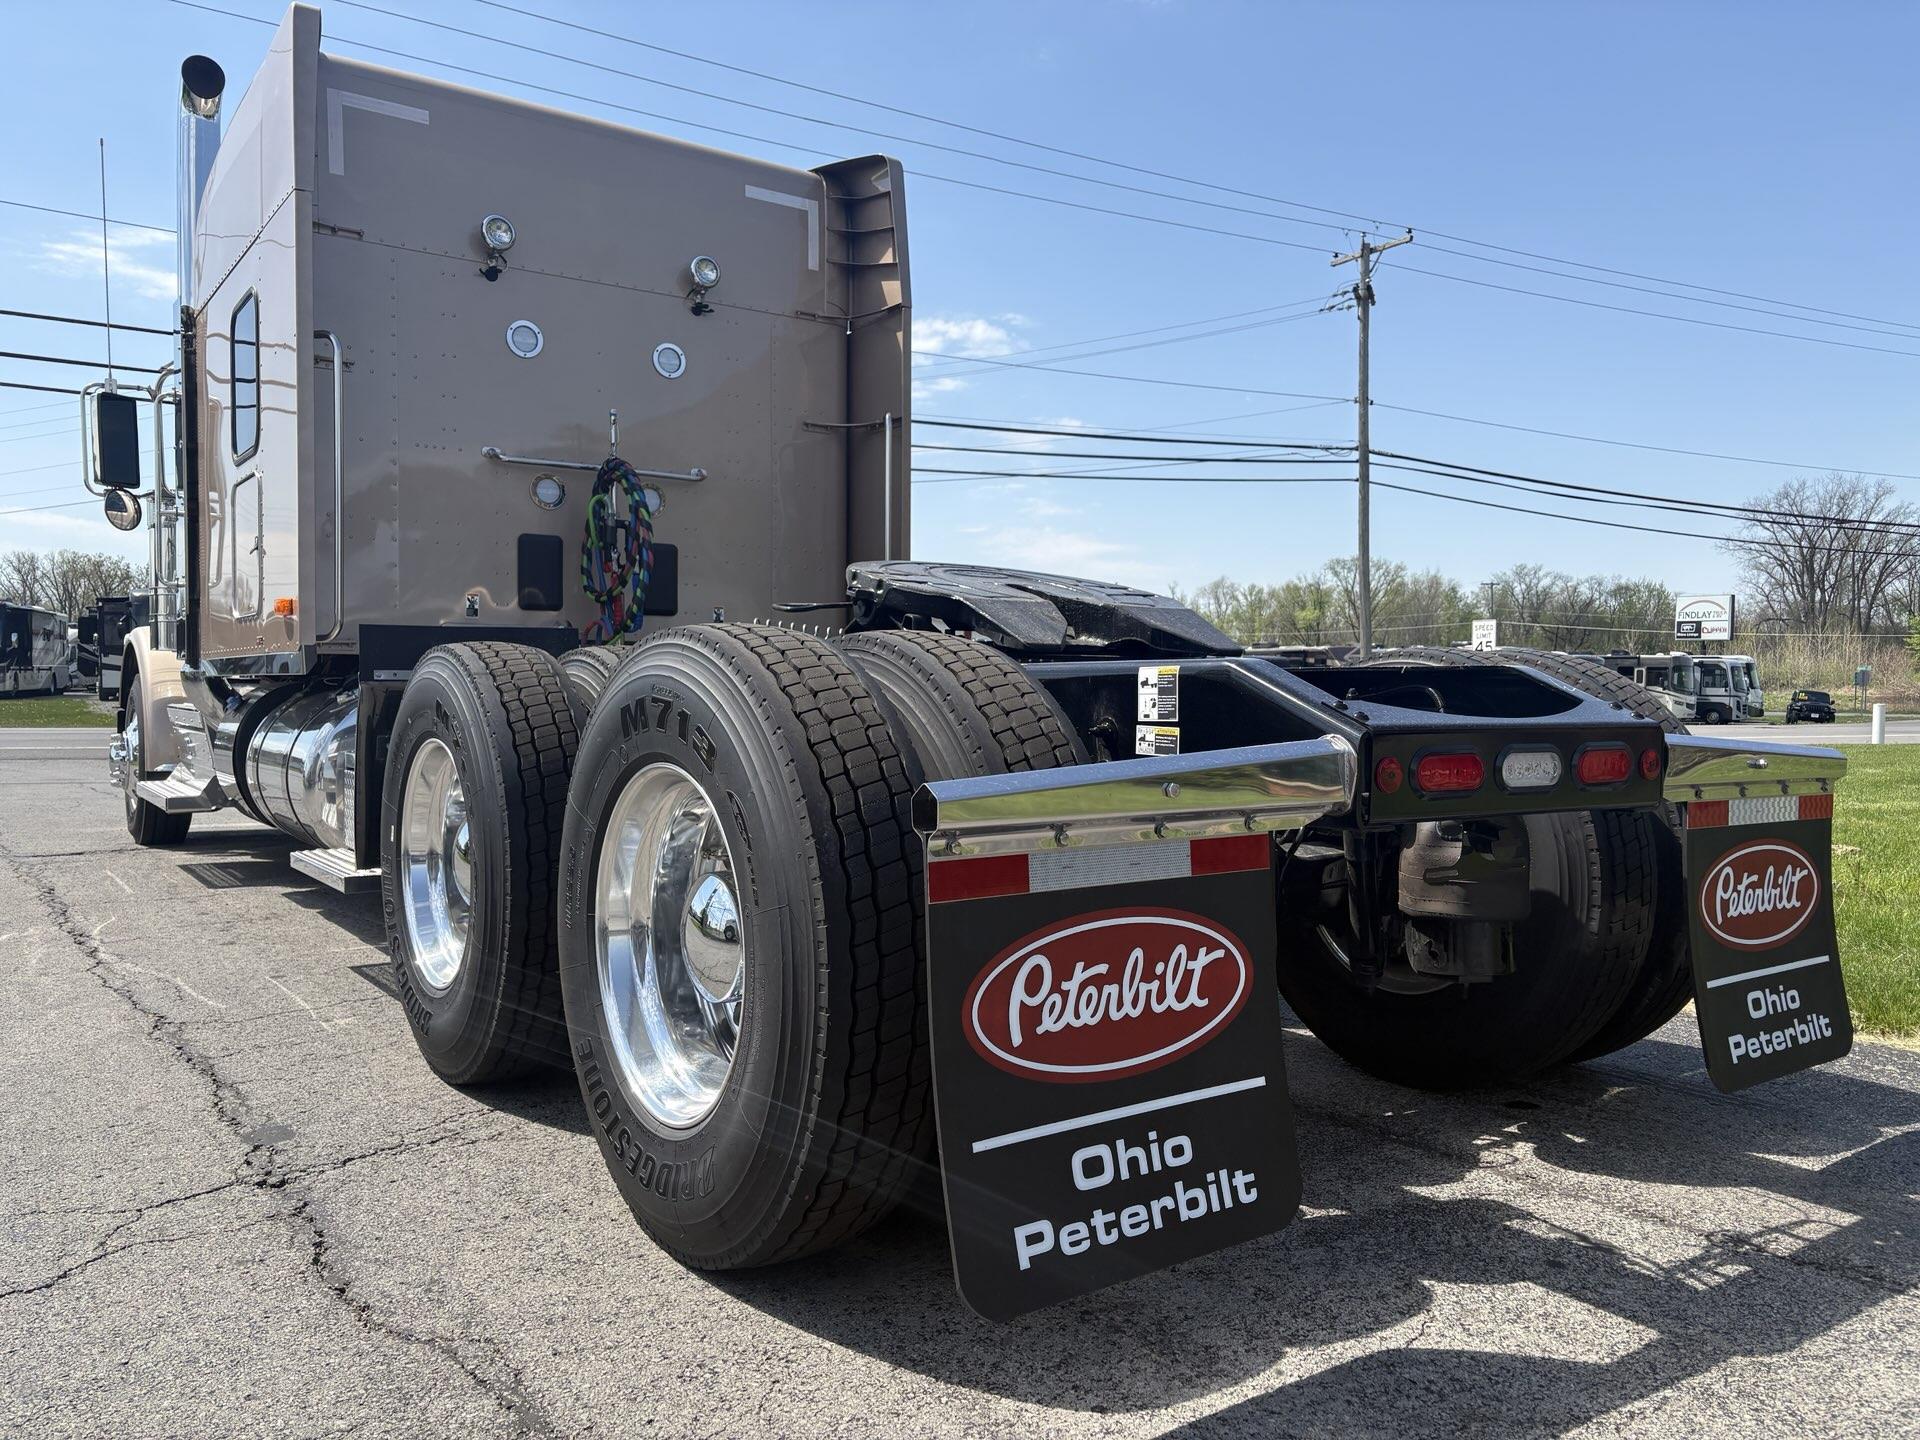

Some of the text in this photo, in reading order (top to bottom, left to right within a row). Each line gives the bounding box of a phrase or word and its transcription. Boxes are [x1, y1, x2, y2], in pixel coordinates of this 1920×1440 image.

[1475, 641, 1492, 651] 45
[1678, 611, 1712, 619] FINDLAY
[1716, 864, 1808, 926] Peterbilt
[1008, 943, 1225, 1048] Peterbilt
[1747, 985, 1800, 1020] Ohio
[1728, 1013, 1833, 1065] Peterbilt
[575, 1034, 718, 1201] BRIDGESTONE
[1071, 1130, 1194, 1192] Ohio
[1013, 1168, 1259, 1272] Peterbilt
